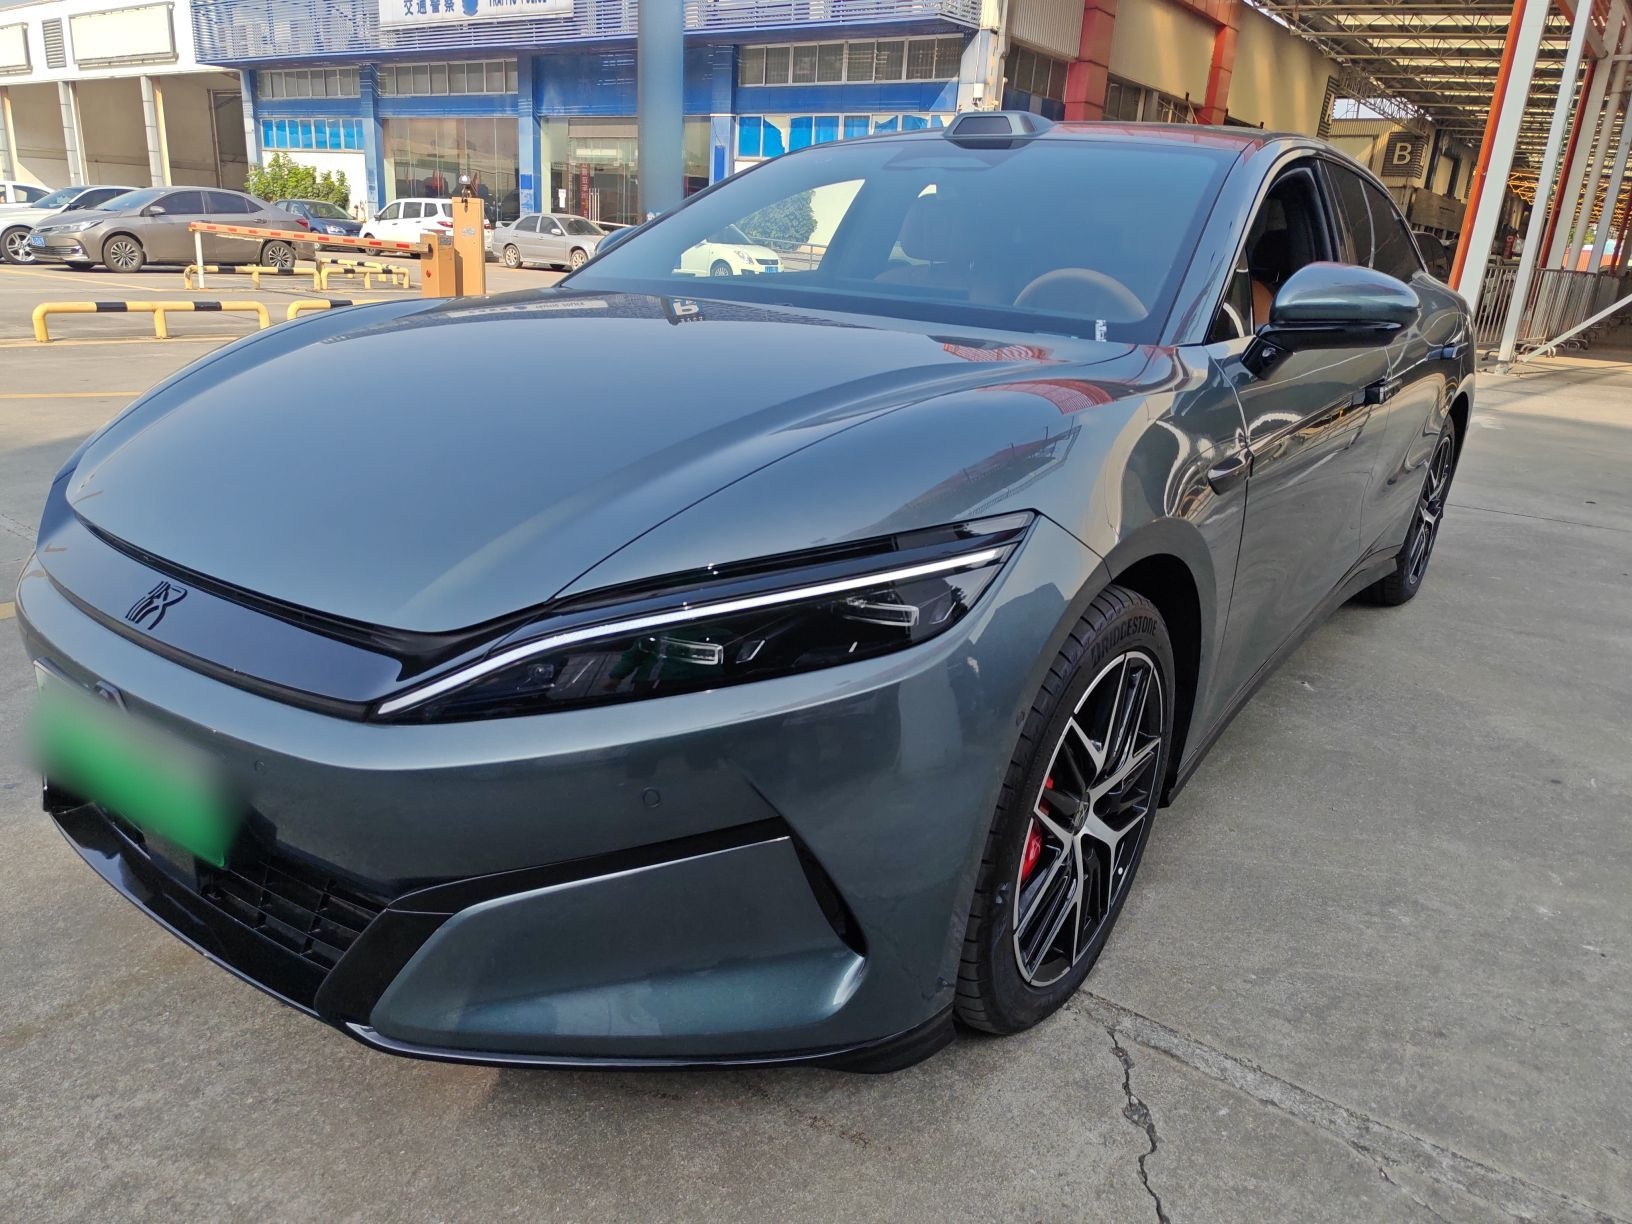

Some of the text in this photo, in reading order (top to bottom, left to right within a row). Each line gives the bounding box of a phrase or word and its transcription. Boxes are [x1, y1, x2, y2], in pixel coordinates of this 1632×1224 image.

[404, 0, 454, 16] 交通警察
[1392, 142, 1412, 165] B
